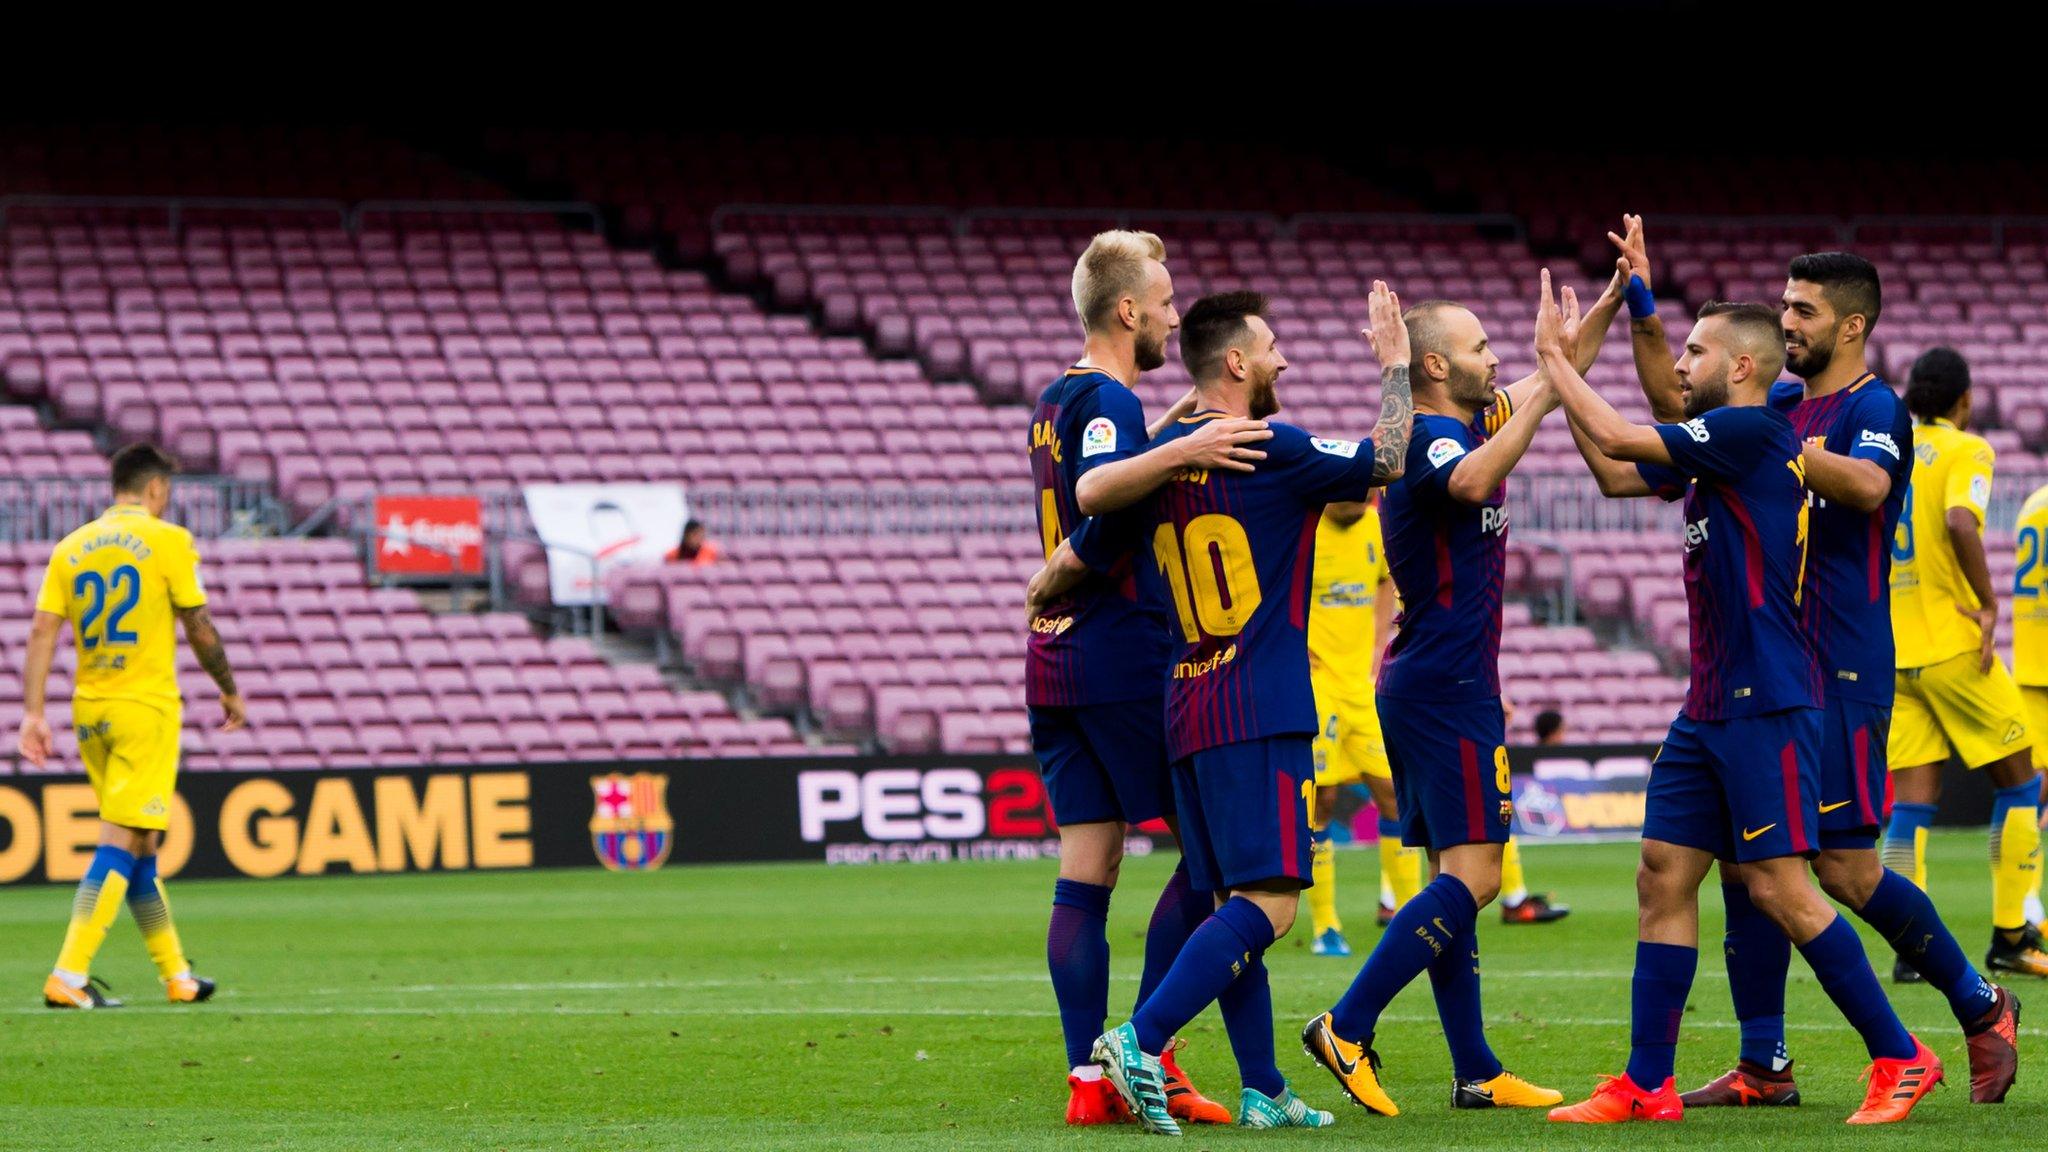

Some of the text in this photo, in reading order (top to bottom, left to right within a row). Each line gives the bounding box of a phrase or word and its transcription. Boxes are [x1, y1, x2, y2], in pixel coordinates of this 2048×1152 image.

[1861, 429, 1900, 460] beko
[1152, 513, 1262, 643] 10
[2013, 526, 2048, 598] 2
[74, 564, 141, 649] 22
[1173, 650, 1222, 679] unicef
[1494, 745, 1512, 794] 8
[219, 771, 534, 878] GAME
